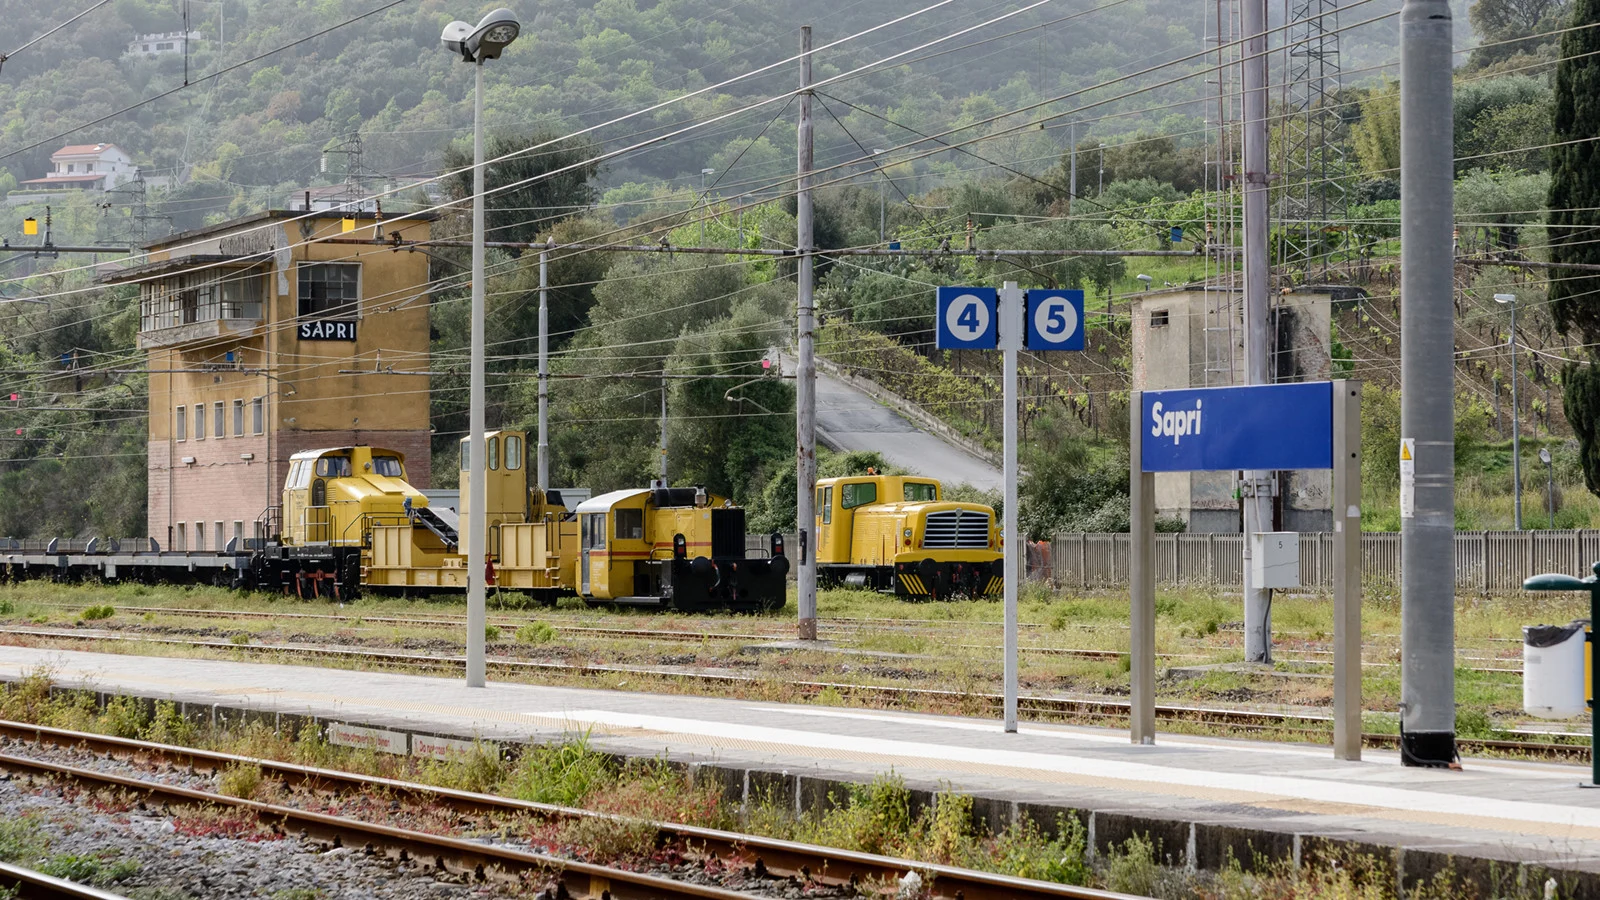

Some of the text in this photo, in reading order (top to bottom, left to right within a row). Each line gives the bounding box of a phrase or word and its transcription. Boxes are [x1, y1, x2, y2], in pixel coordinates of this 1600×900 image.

[301, 321, 354, 338] SAPRI
[957, 303, 980, 333] 4
[1046, 304, 1066, 335] 5
[1151, 399, 1202, 445] Sapri
[1278, 540, 1283, 549] 5
